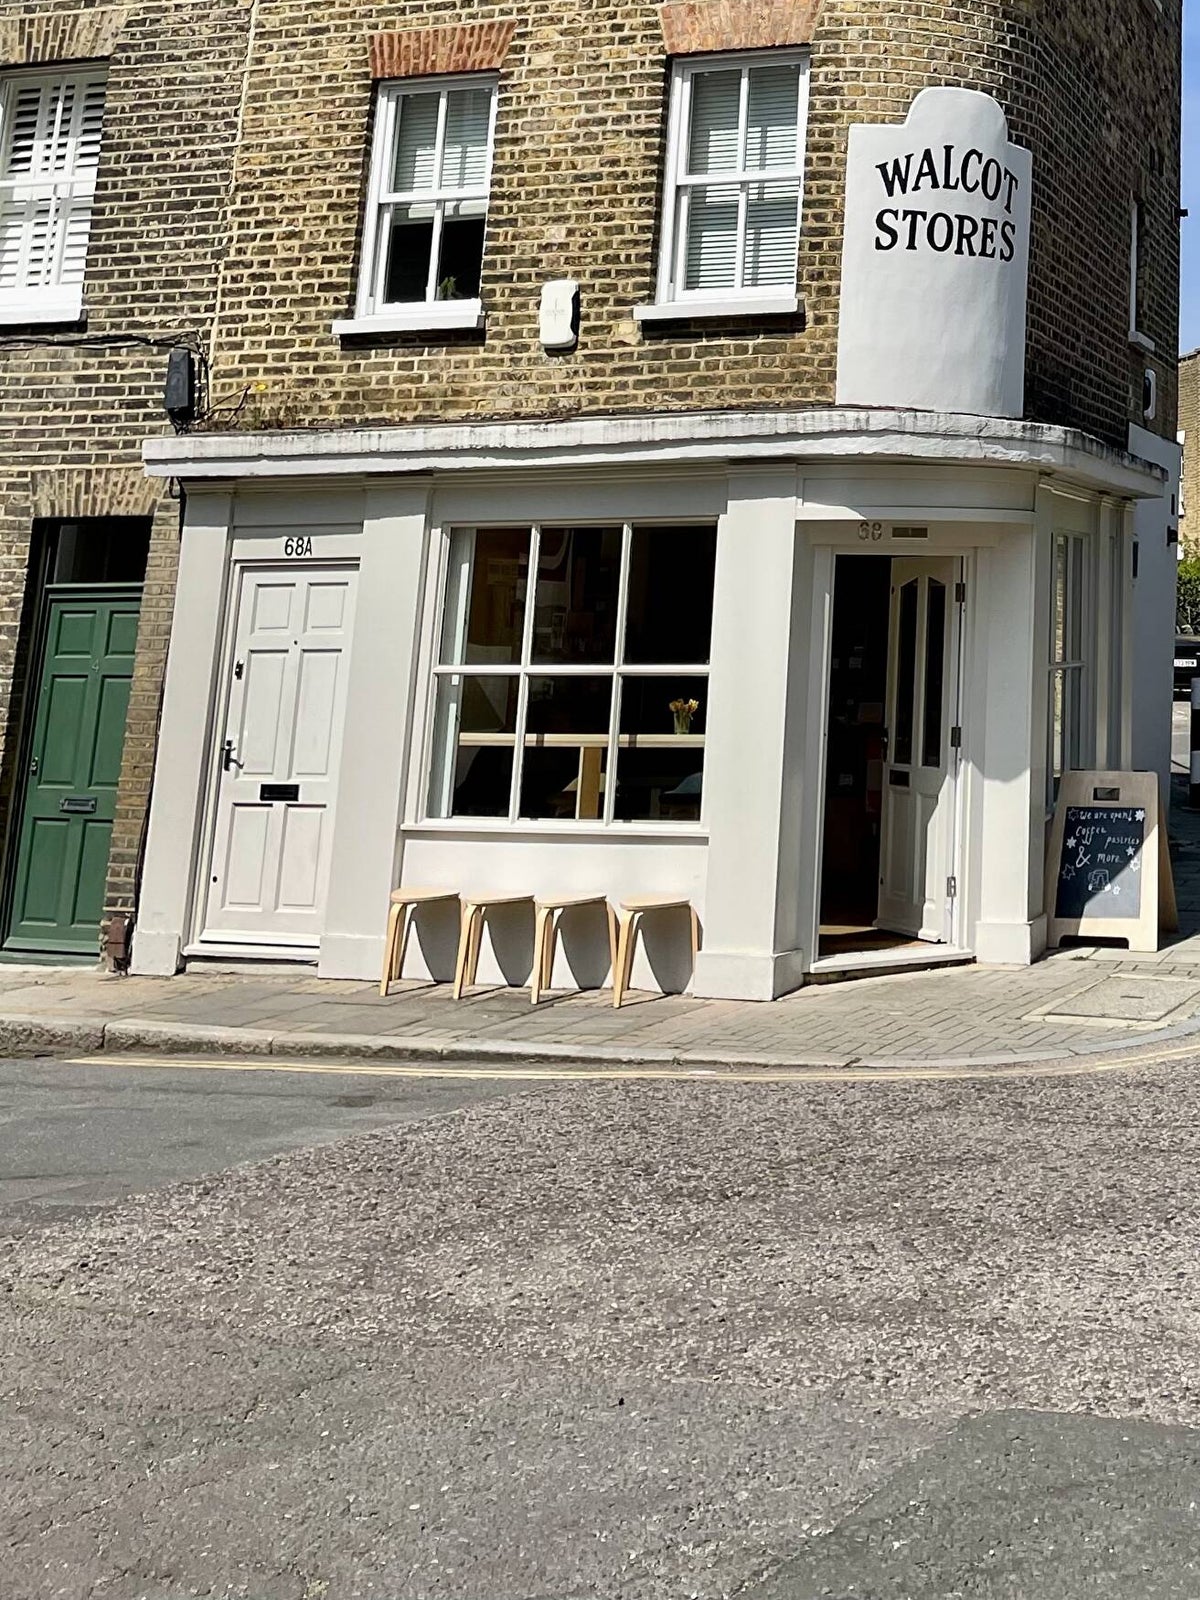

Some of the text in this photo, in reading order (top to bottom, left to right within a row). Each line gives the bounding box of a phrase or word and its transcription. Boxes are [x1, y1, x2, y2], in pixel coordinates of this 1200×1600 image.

[875, 145, 1019, 214] WALCOT
[875, 208, 1016, 263] STORES
[858, 522, 883, 541] 68
[284, 537, 313, 556] 68A
[91, 659, 99, 673] 4
[1076, 846, 1091, 868] &
